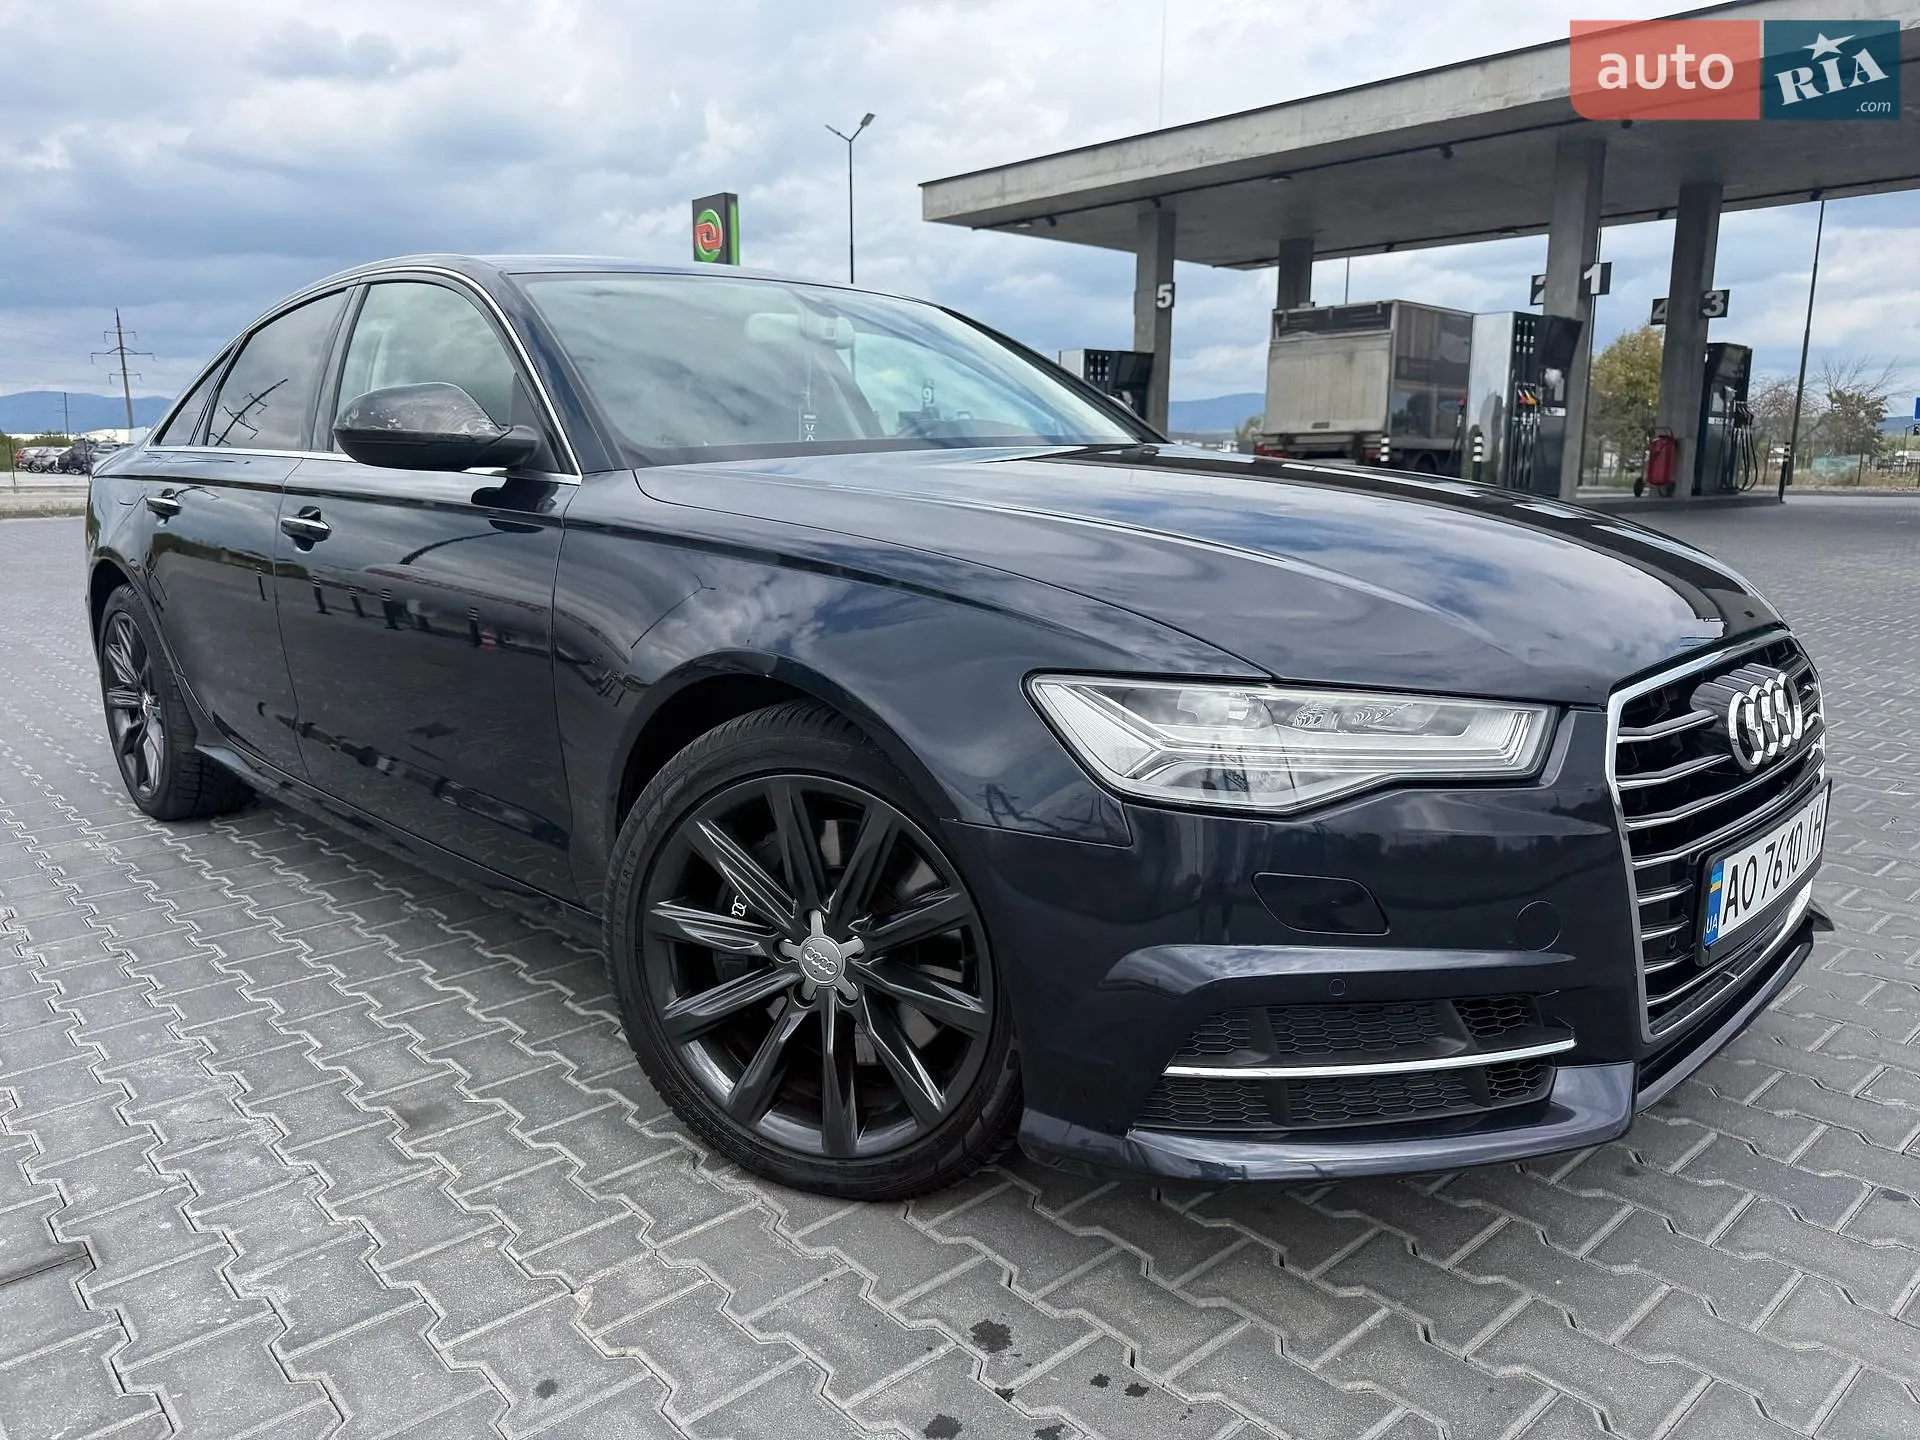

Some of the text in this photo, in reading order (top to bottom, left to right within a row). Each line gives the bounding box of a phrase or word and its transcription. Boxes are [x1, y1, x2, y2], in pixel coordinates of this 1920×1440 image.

[1583, 263, 1601, 295] 1
[1156, 283, 1172, 309] 5
[1702, 291, 1725, 317] 3
[1722, 855, 1757, 926] AO
[1761, 821, 1803, 900] 7610
[1706, 915, 1718, 934] UA
